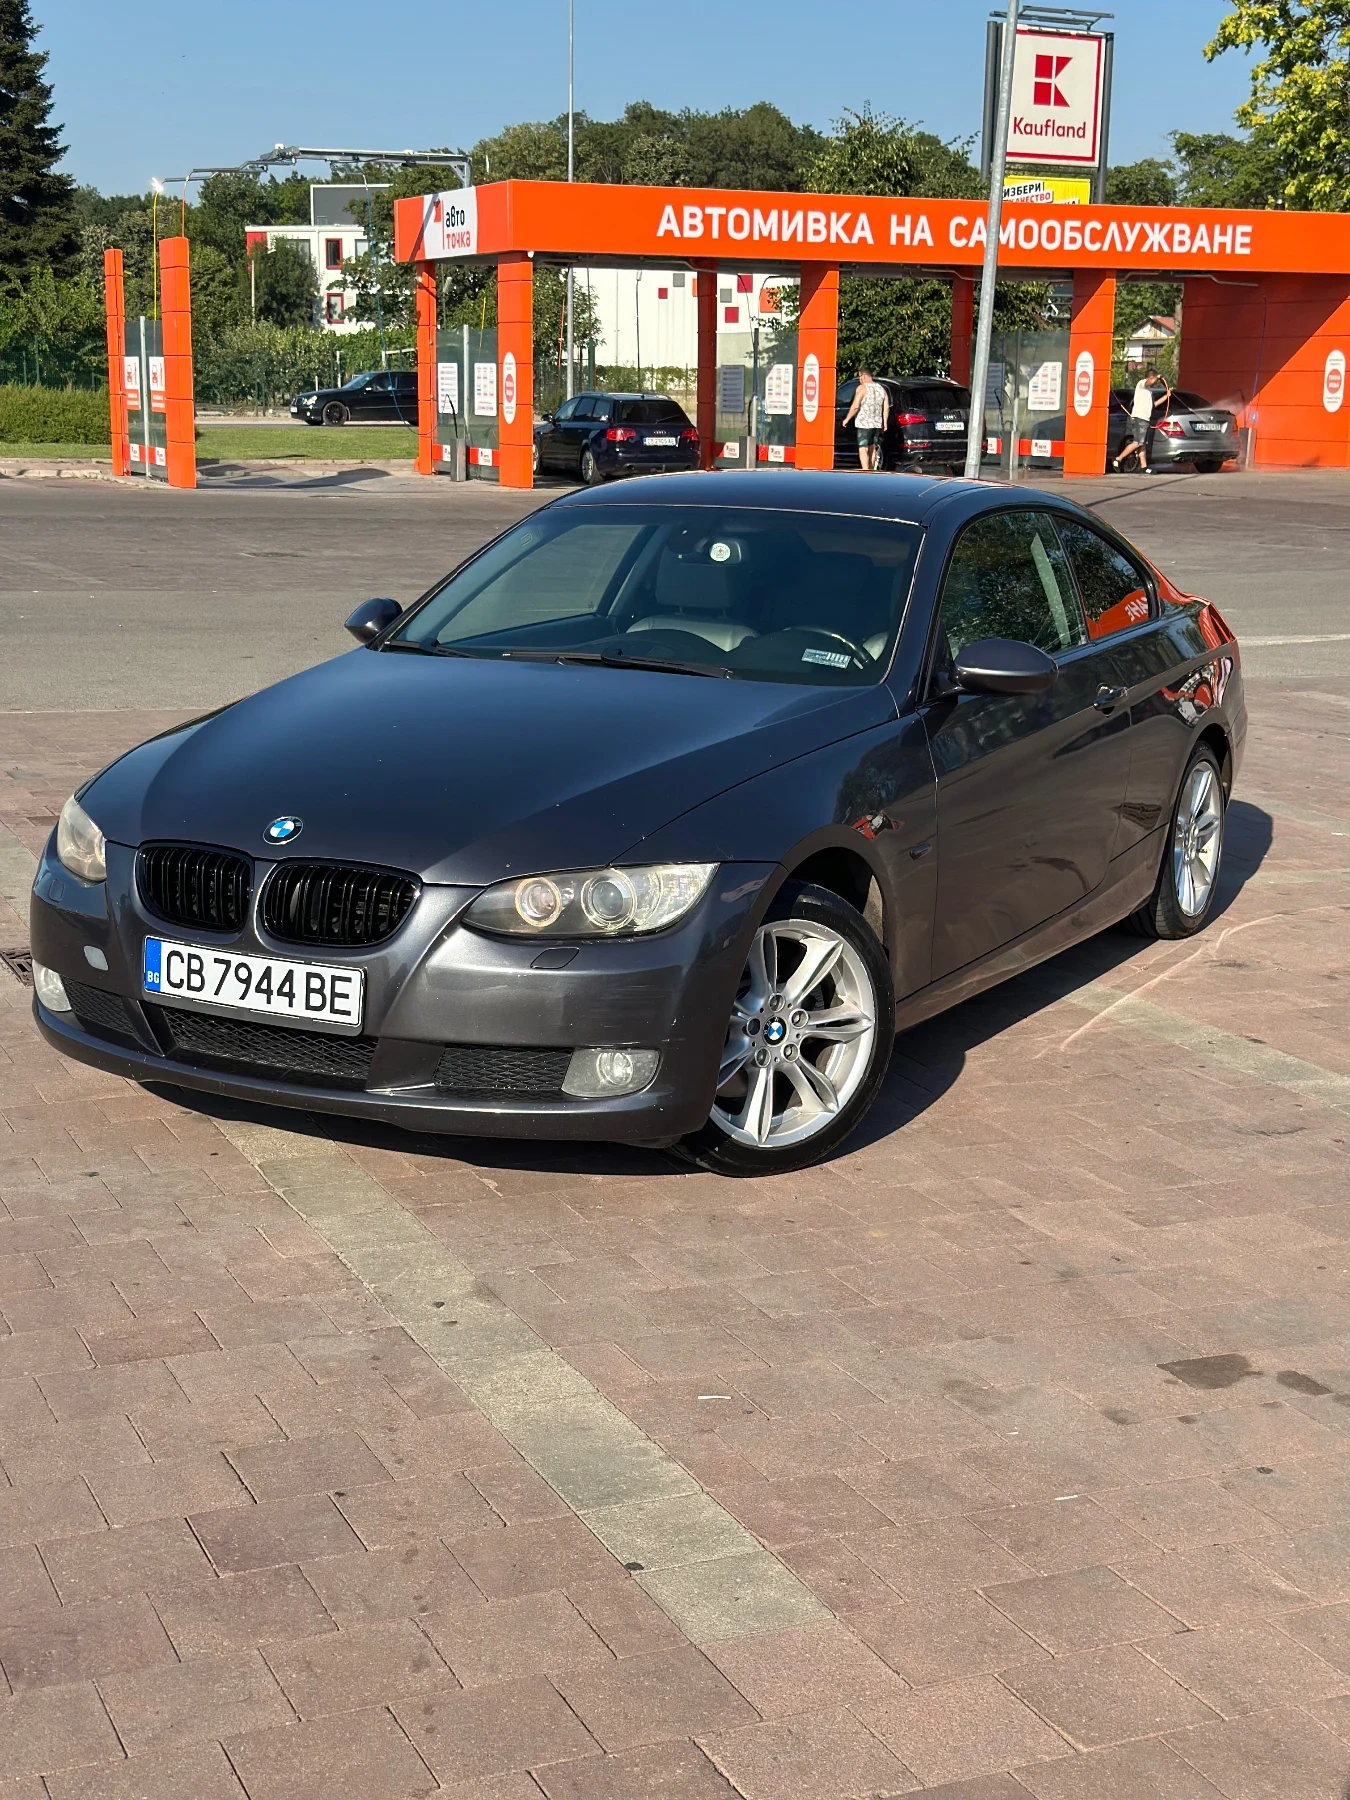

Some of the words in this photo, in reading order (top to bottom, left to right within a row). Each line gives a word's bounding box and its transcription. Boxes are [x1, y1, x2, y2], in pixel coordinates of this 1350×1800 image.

[1013, 116, 1087, 139] Kaufland
[1003, 182, 1041, 198] ИЗБЕРИ
[445, 205, 466, 228] авто
[446, 230, 471, 250] точка
[656, 204, 875, 245] АВТОМИВКА
[889, 214, 934, 246] НА
[949, 215, 1253, 255] САМООБСЛУЖВАНЕ
[147, 970, 160, 984] BG
